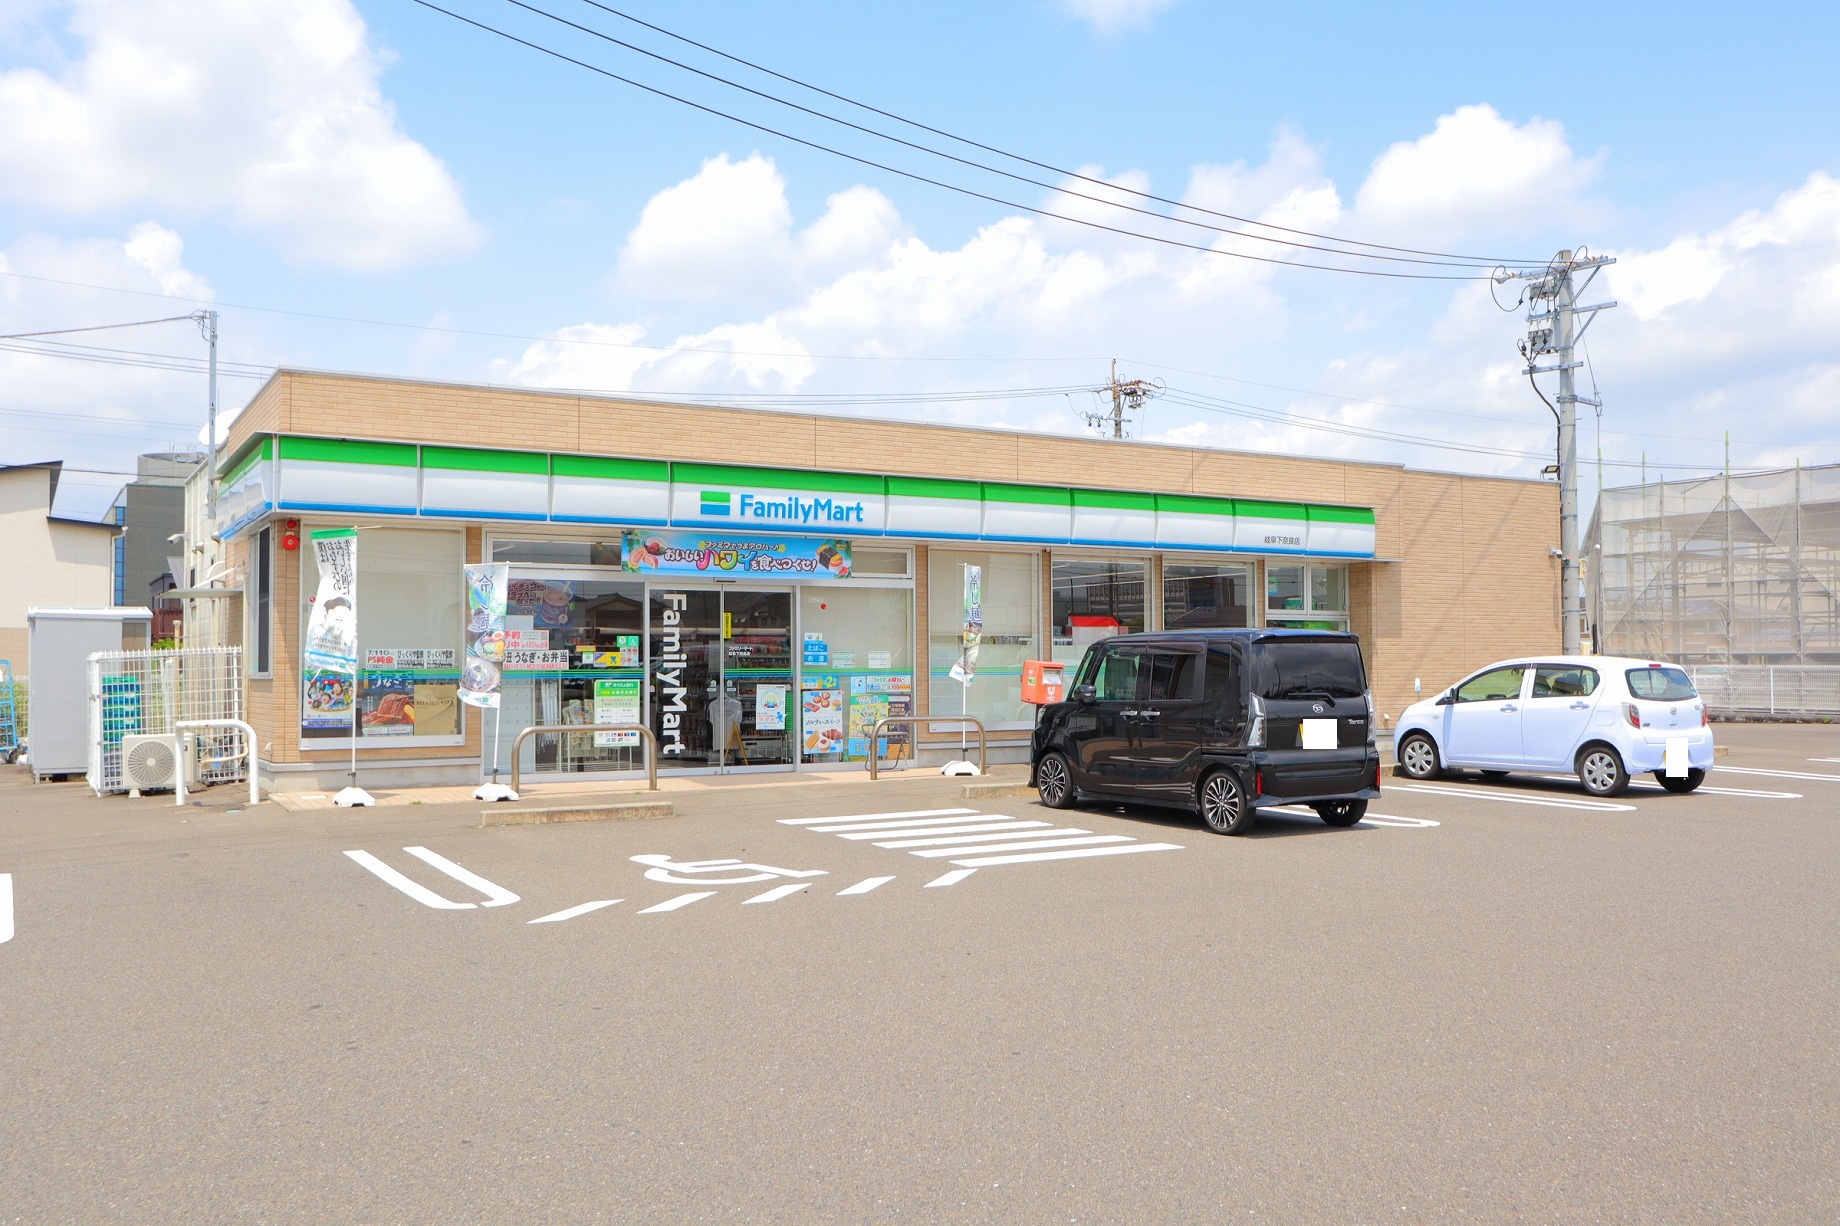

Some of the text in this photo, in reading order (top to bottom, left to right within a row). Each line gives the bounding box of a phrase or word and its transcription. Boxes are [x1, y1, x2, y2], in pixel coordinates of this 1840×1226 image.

[740, 494, 863, 524] FamilyMart
[1264, 535, 1301, 546] 岐阜下奈良店
[969, 575, 983, 627] 冷し麺
[514, 651, 568, 664] うなぎ・お弁当
[656, 593, 688, 756] FamilyMart
